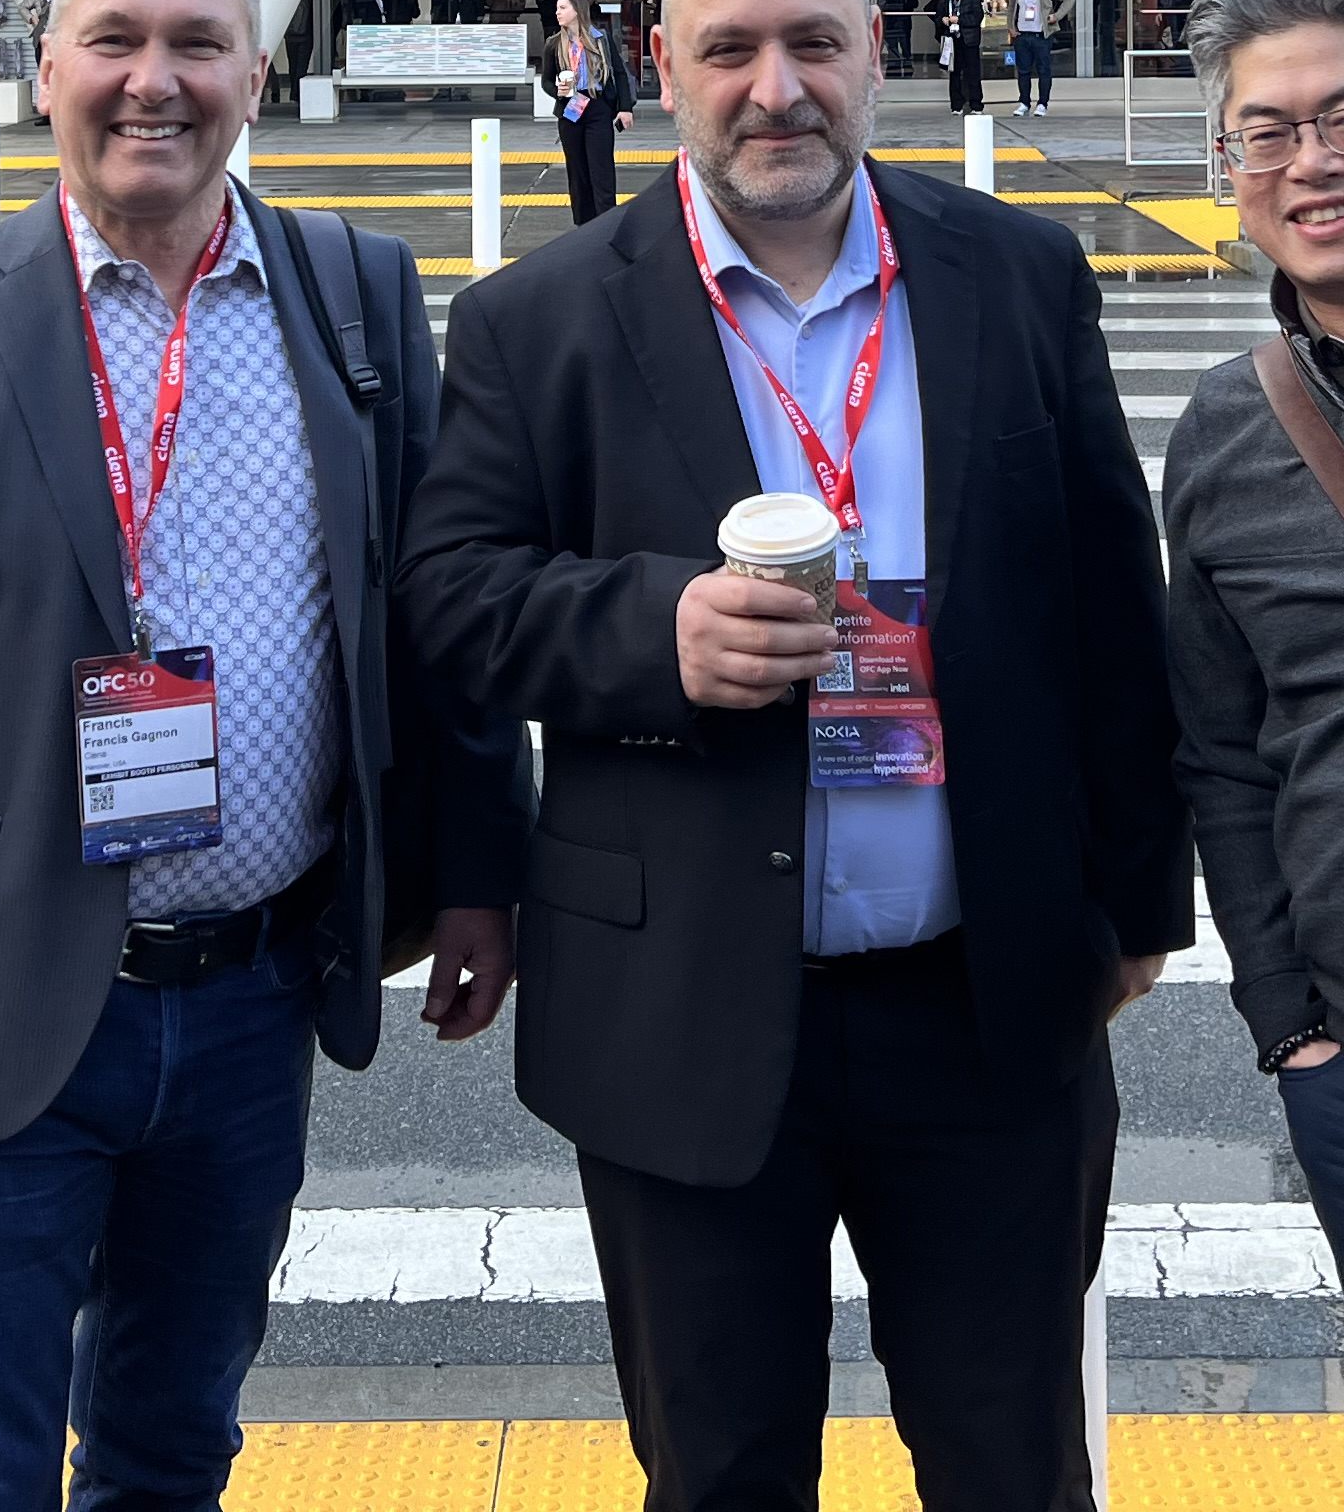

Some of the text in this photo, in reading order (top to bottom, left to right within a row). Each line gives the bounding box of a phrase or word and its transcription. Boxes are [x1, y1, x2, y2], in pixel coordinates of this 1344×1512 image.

[880, 226, 895, 266] ciena
[163, 338, 182, 386] ciena
[848, 360, 873, 408] ciena
[779, 391, 809, 437] ciena
[154, 412, 177, 462] ciena
[104, 446, 127, 495] ciena
[834, 614, 872, 628] petite
[859, 656, 894, 664] Download
[859, 665, 876, 673] OFC
[876, 666, 891, 674] App
[890, 683, 910, 693] intel
[82, 716, 133, 733] Francis
[815, 725, 861, 738] NOKIA
[84, 728, 178, 748] Francis Gagnon
[875, 752, 924, 761] innovation
[130, 767, 156, 777] BOOTH
[156, 761, 200, 774] PERSONNEL
[874, 763, 929, 776] hyperscaled
